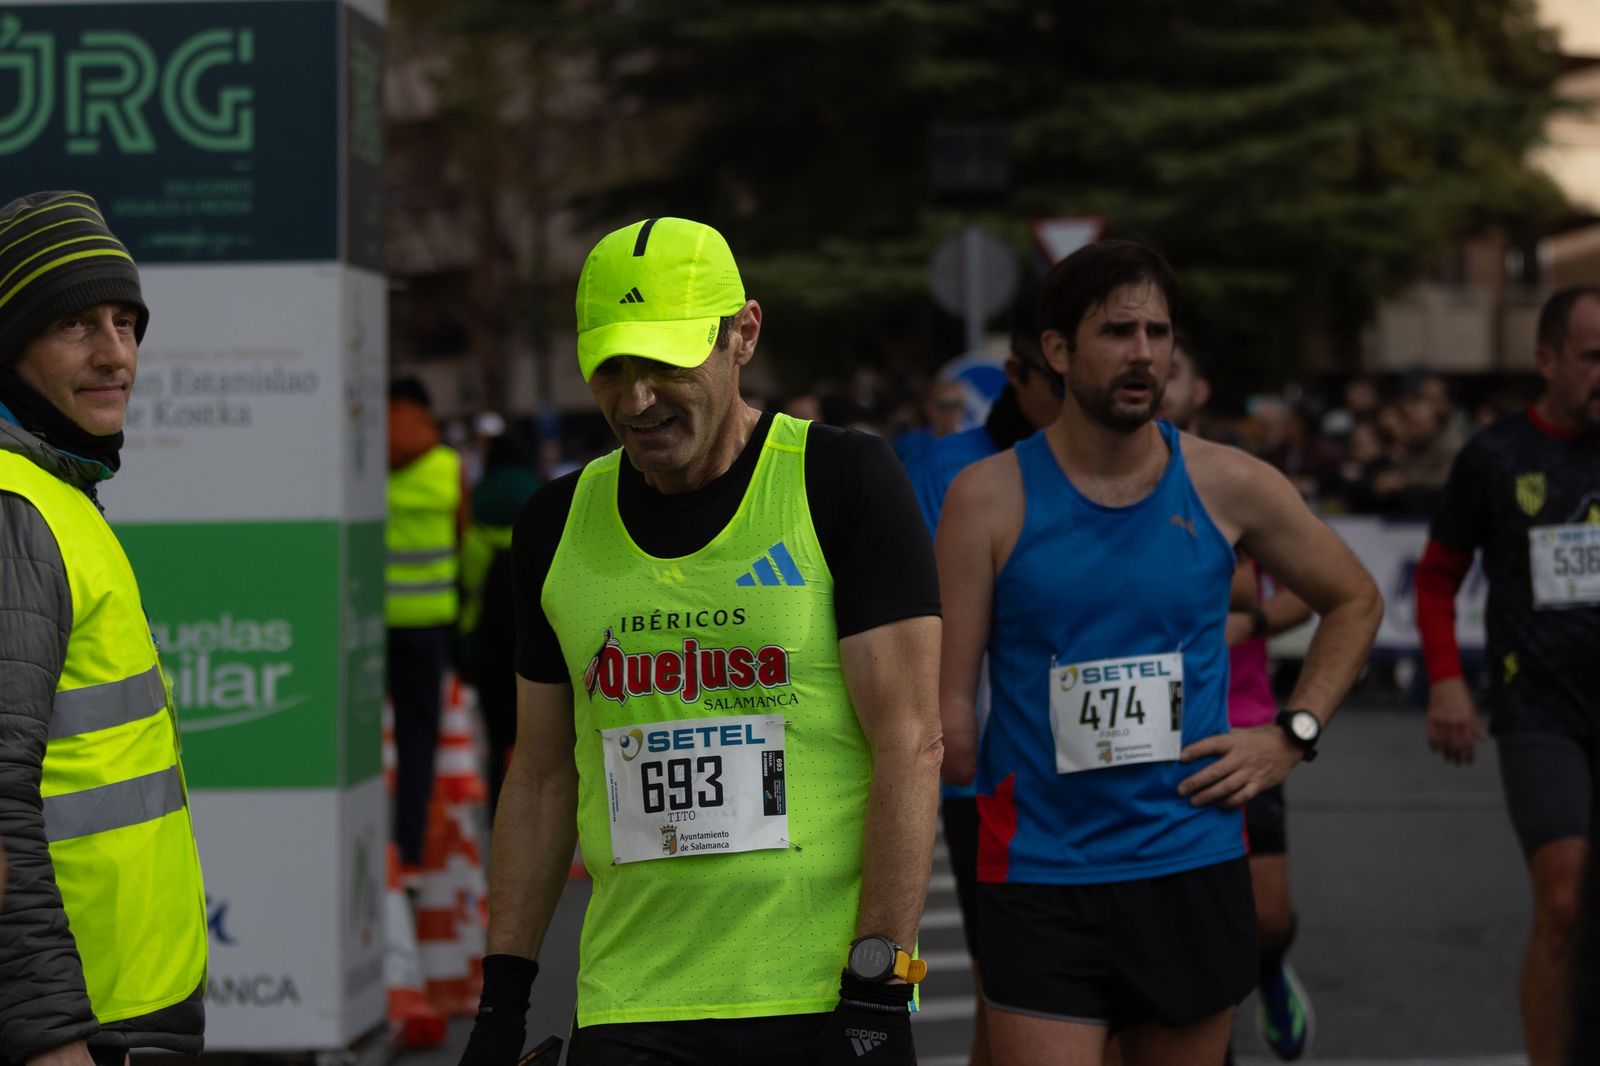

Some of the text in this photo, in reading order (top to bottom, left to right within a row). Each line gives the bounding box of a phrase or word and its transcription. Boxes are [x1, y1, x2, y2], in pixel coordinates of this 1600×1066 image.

[132, 371, 164, 396] an
[155, 613, 293, 653] uelas
[620, 608, 746, 633] IBÉRICOS
[178, 654, 294, 709] ilar
[598, 638, 791, 706] Quejusa
[1082, 661, 1170, 684] SETEL
[704, 693, 799, 711] SALAMANCA
[1079, 686, 1145, 731] 474
[647, 724, 766, 753] SETEL
[641, 756, 724, 814] 693
[667, 811, 696, 823] TITO
[680, 830, 729, 844] Ayuntamiento
[680, 841, 730, 852] de Salamanca
[207, 973, 302, 1007] ANCA
[845, 1026, 888, 1041] adidas
